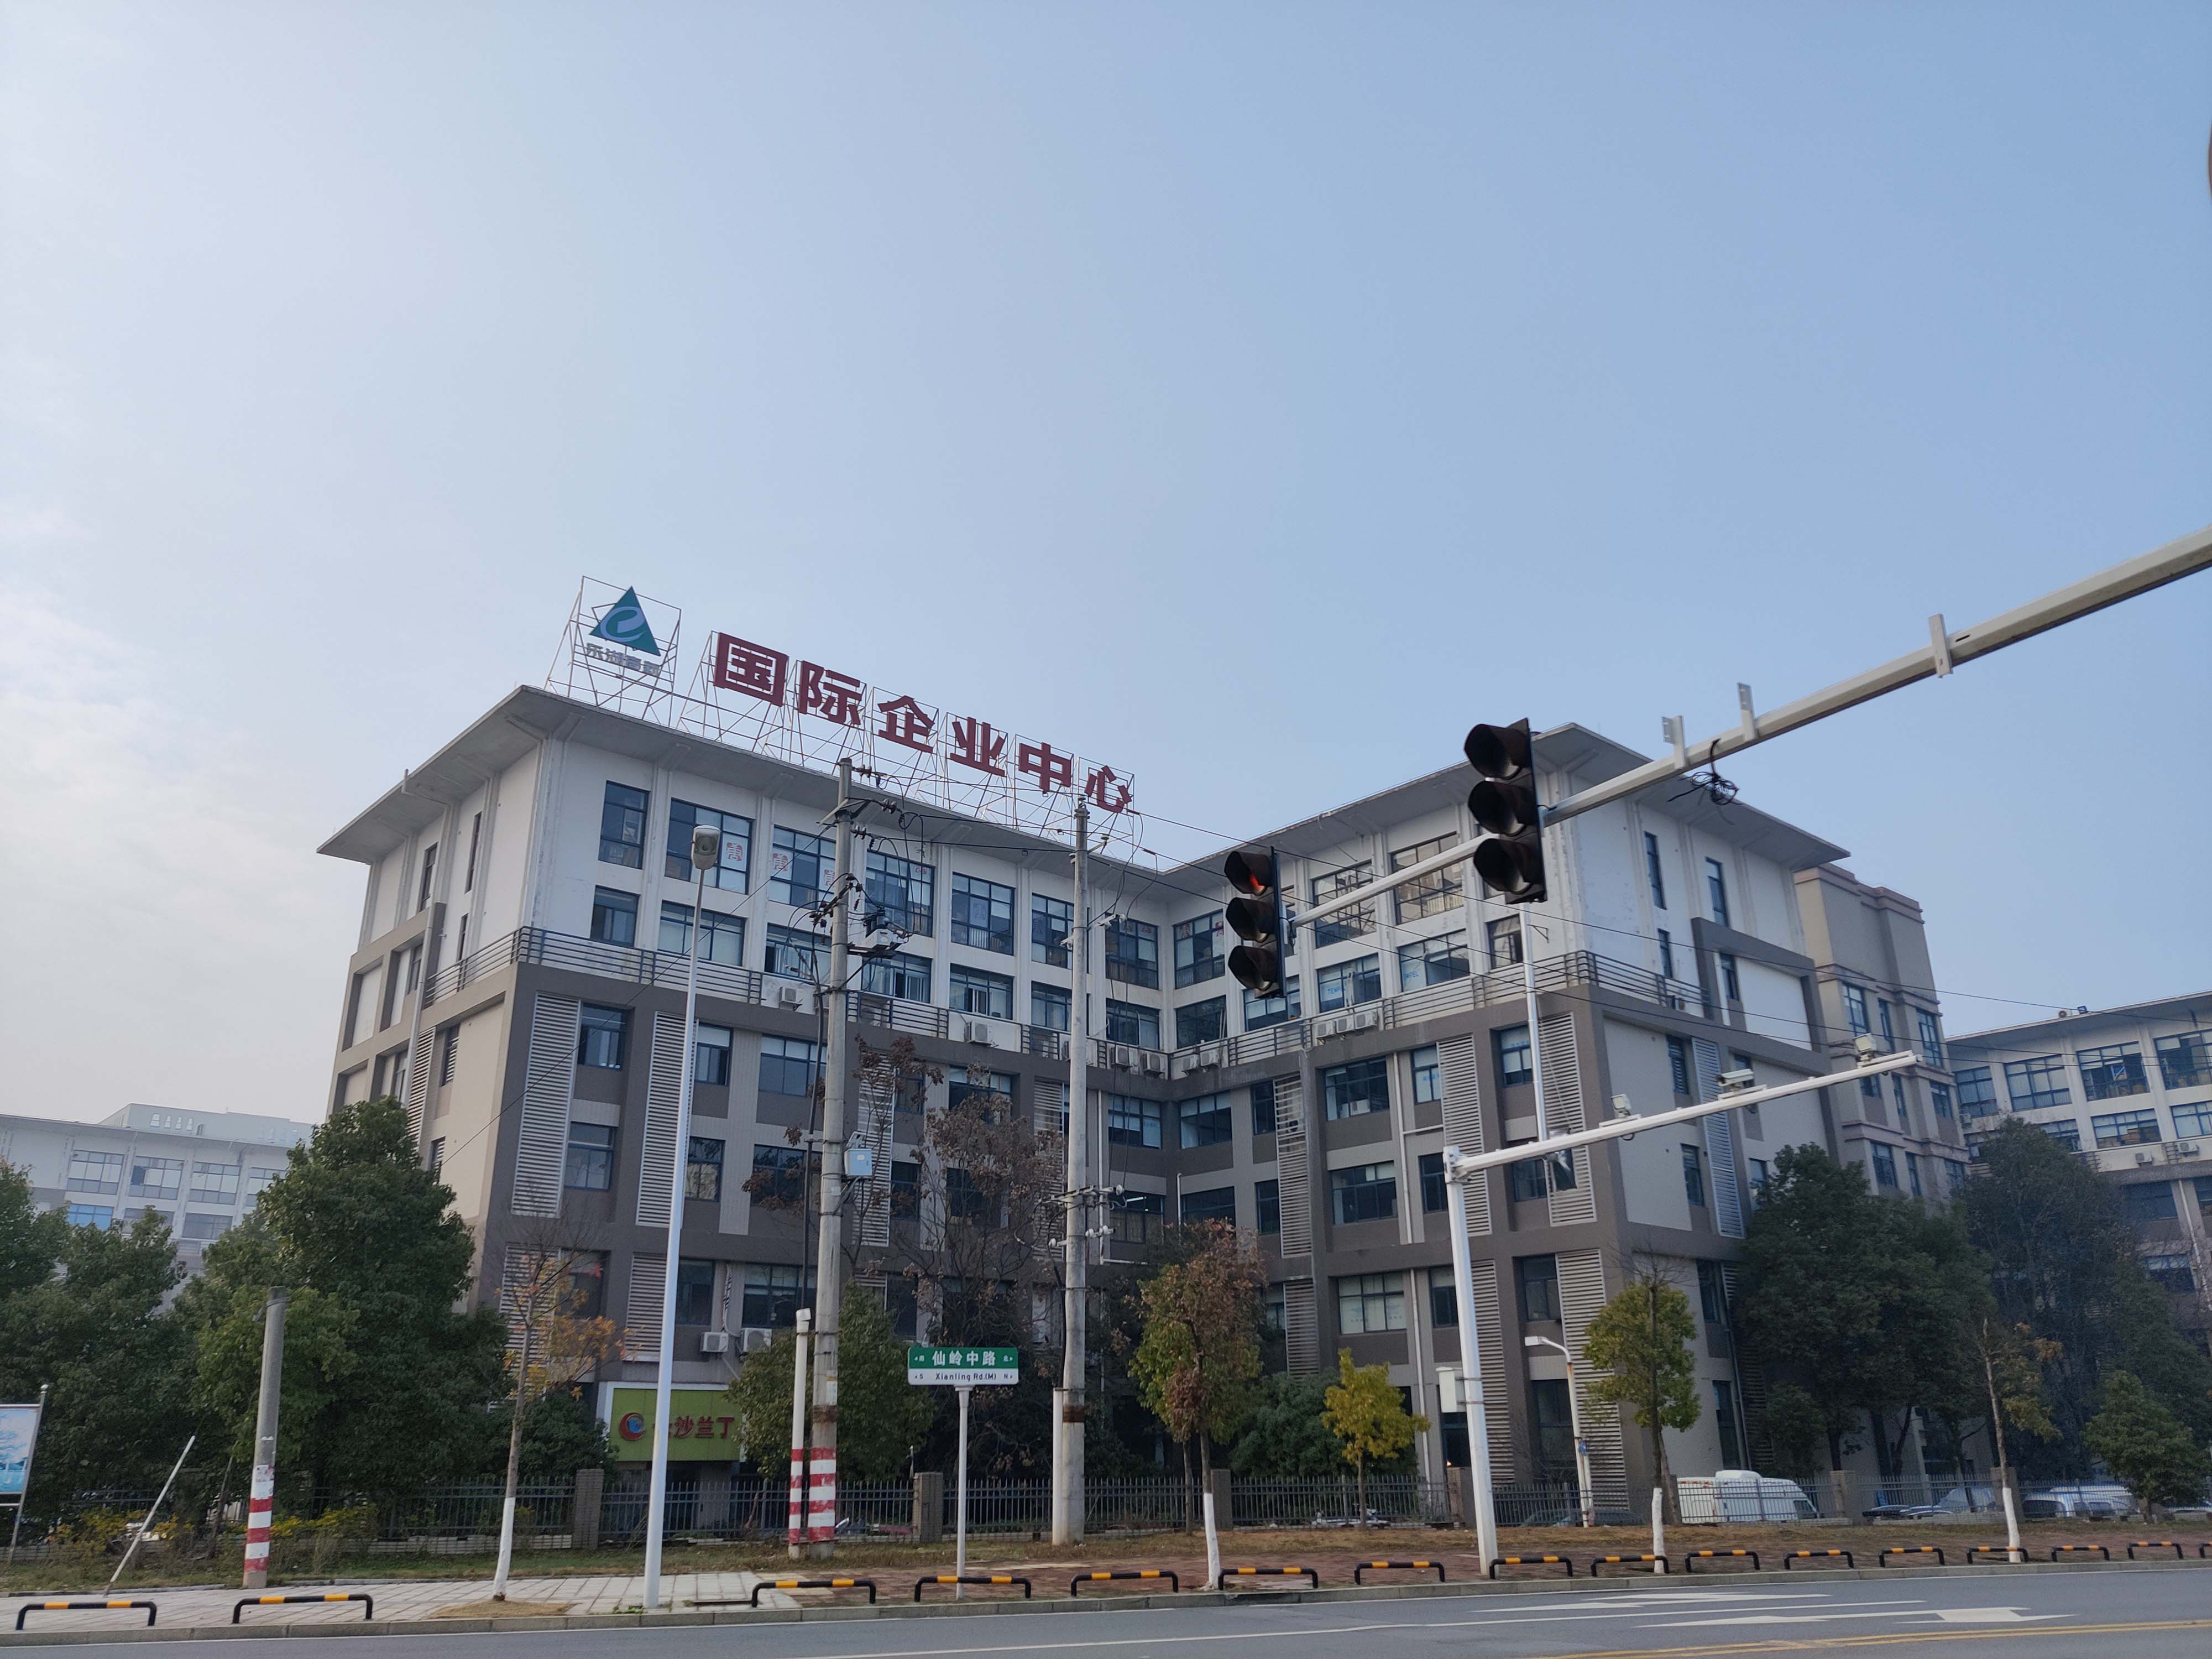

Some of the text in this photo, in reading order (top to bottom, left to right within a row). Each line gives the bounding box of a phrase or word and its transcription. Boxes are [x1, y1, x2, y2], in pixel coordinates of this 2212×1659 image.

[713, 632, 1132, 813] 国际企业中心
[932, 1350, 996, 1366] 仙岭中路
[935, 1373, 970, 1381] Xianling
[653, 1415, 735, 1439] 沙兰丁
